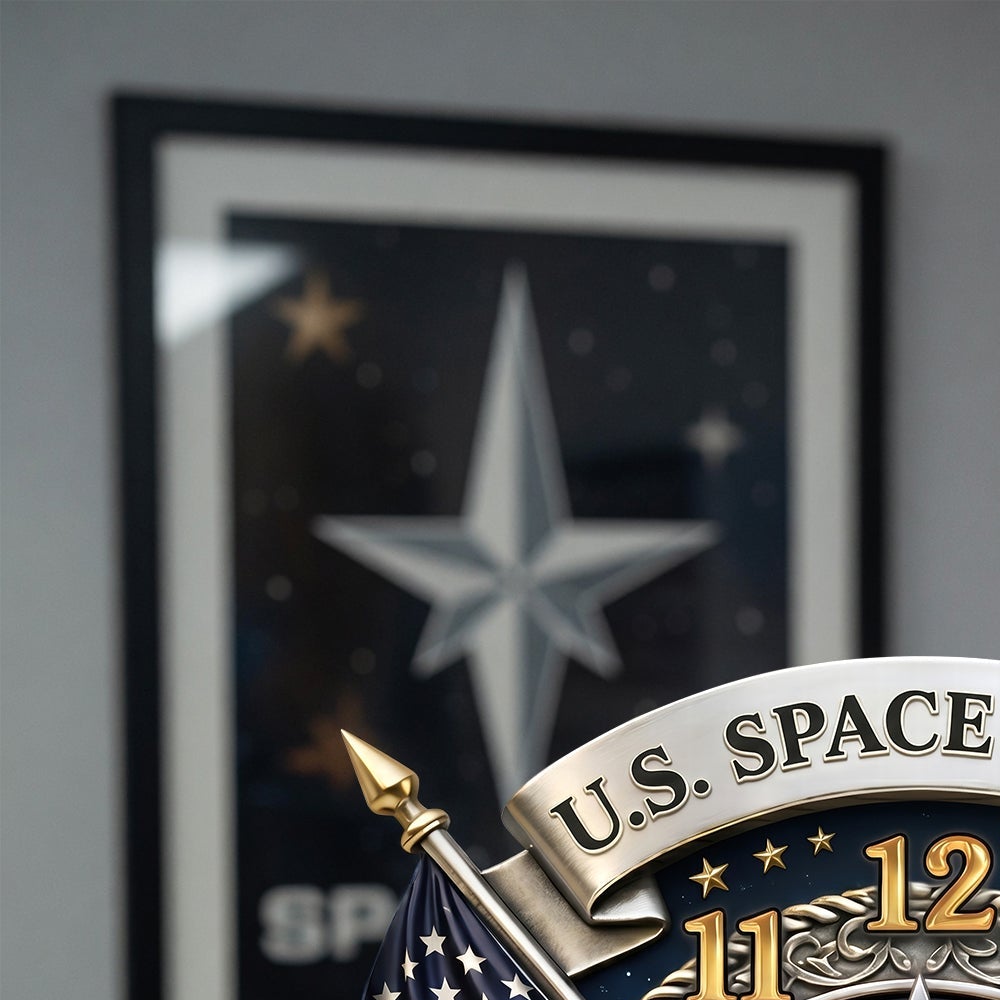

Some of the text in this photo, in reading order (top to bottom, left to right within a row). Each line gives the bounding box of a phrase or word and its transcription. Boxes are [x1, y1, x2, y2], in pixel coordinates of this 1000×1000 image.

[550, 745, 712, 852] U.S.
[724, 690, 995, 781] SPACE
[862, 833, 996, 935] 12
